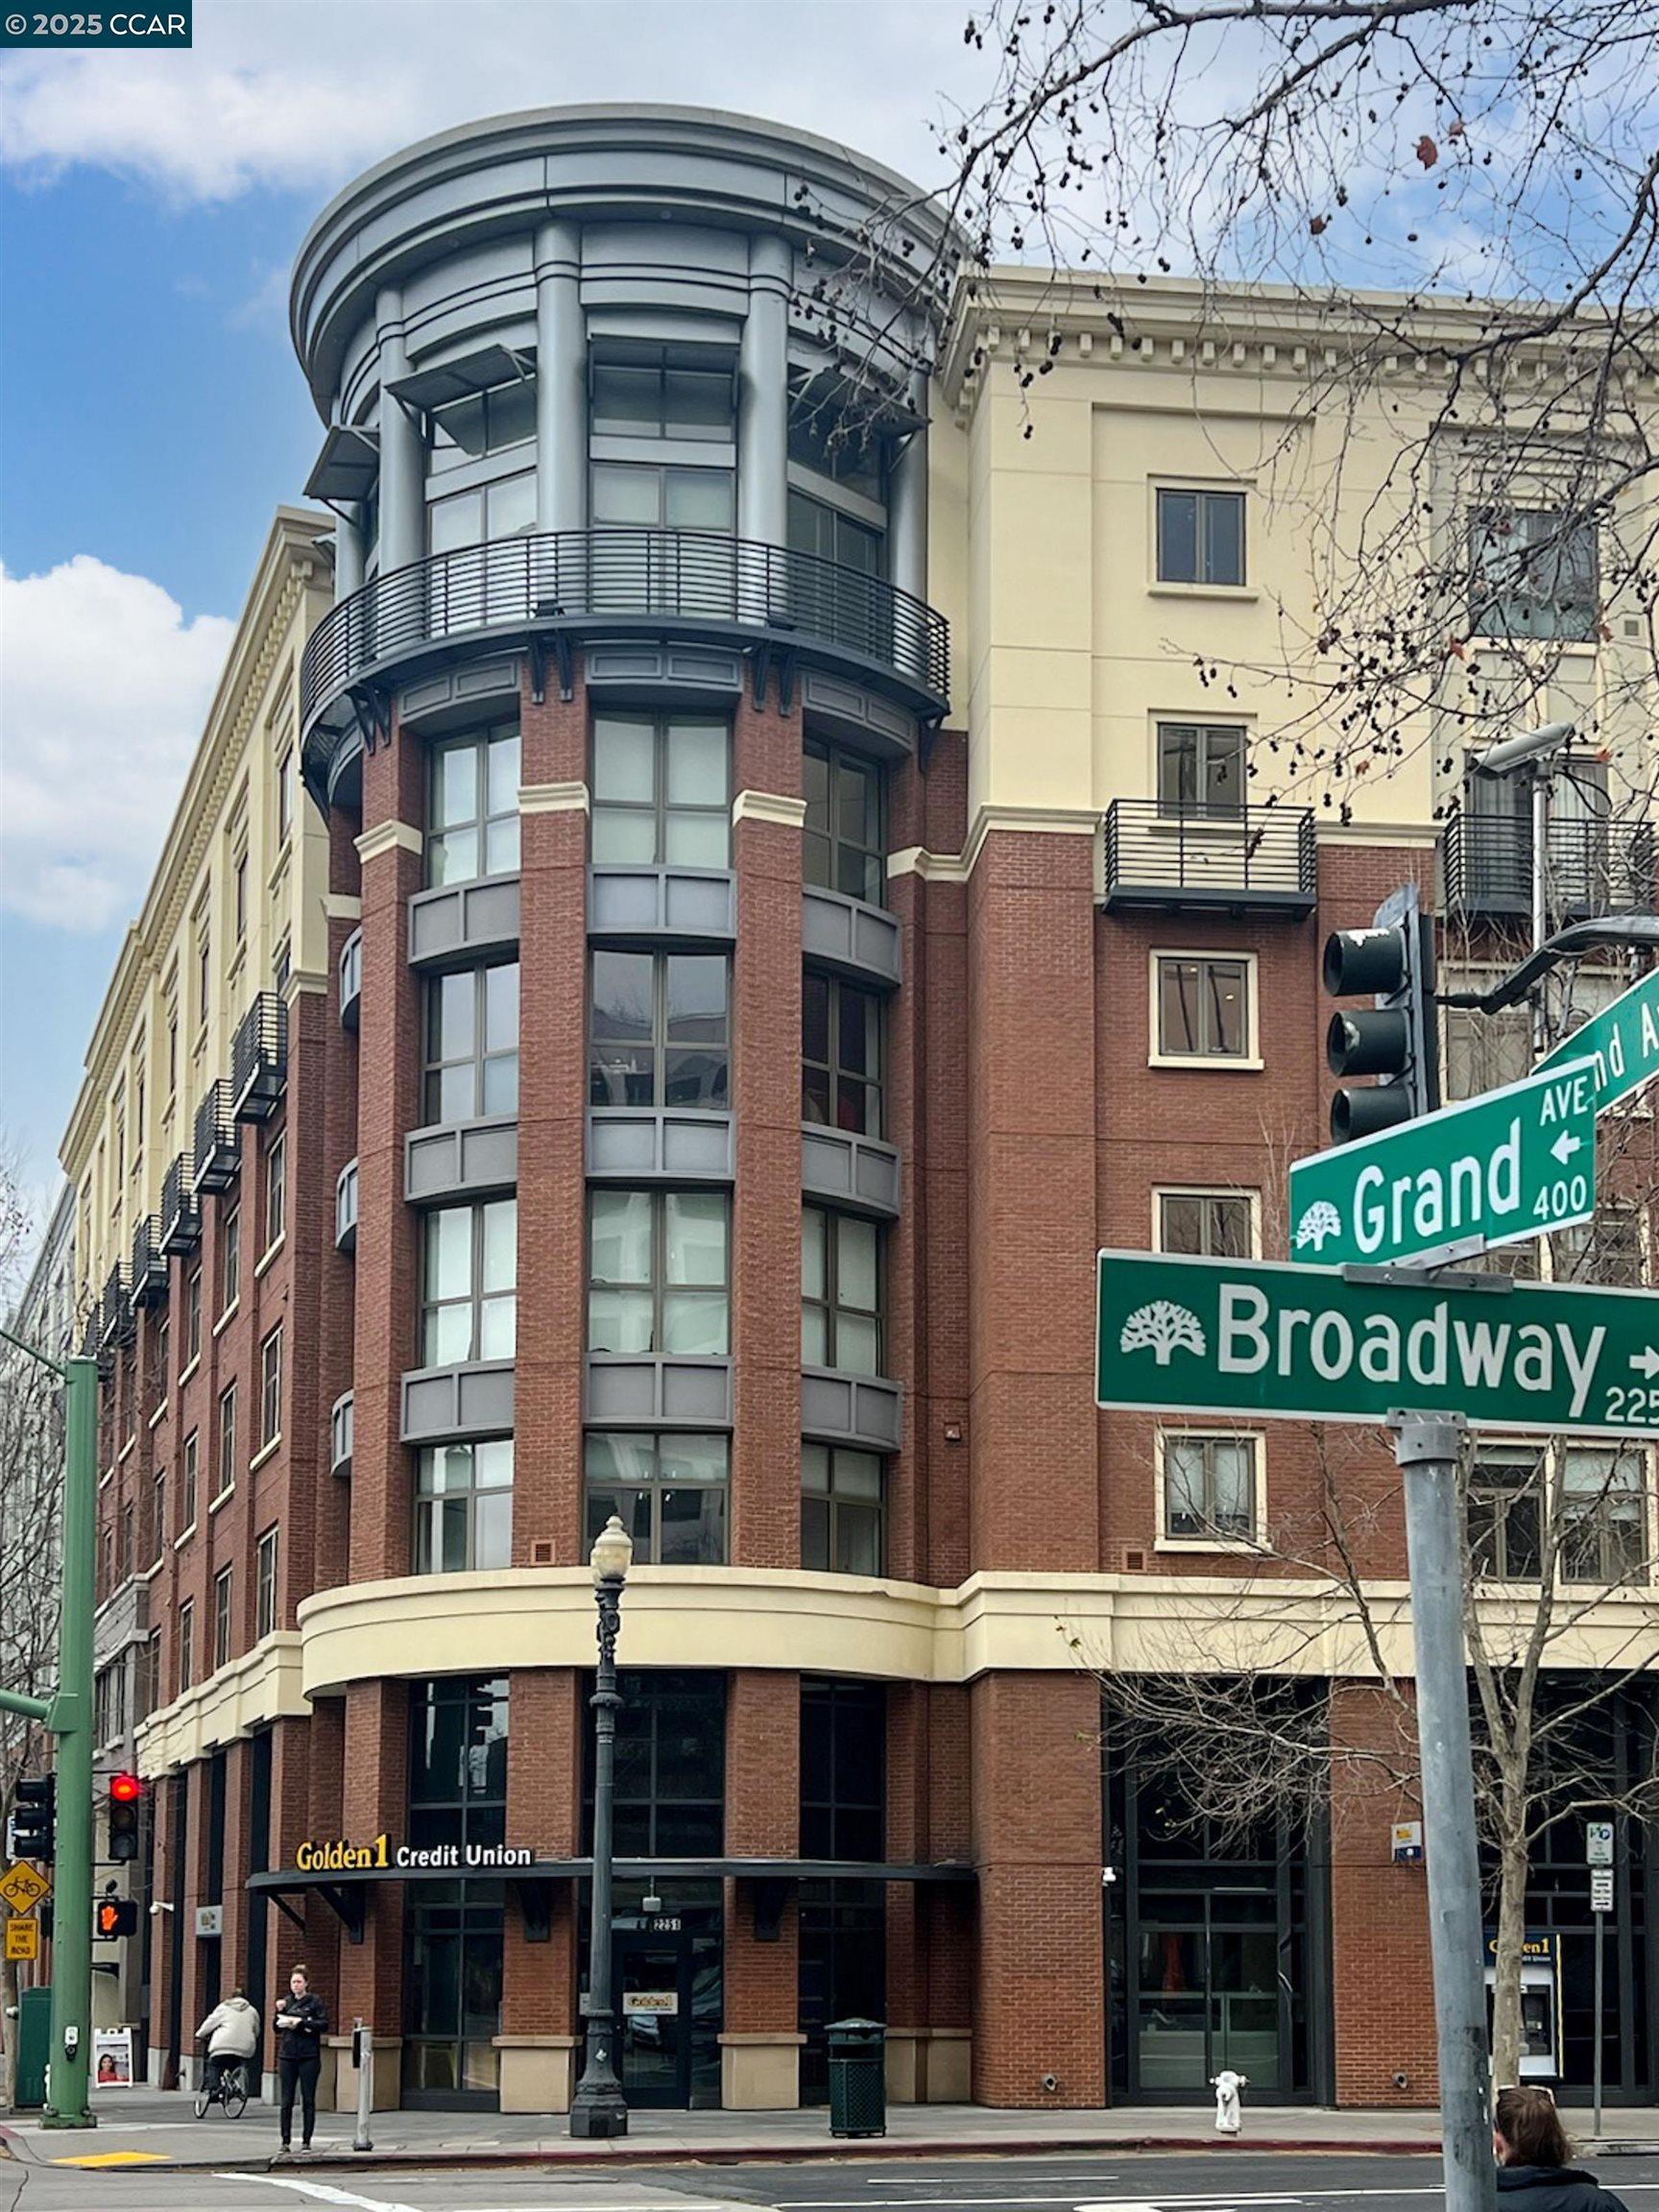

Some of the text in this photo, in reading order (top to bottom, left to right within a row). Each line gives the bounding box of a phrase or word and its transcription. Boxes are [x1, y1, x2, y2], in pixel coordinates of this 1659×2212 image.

[1353, 1075, 1588, 1254] Grand AVE
[1533, 1175, 1587, 1220] 400
[1217, 1284, 1606, 1418] Broadway
[397, 1845, 459, 1867] Credit
[466, 1844, 531, 1865] Union
[10, 1923, 34, 1932] SHARE
[15, 1935, 27, 1943] THE
[1489, 1937, 1550, 1954] Gen1
[11, 1945, 31, 1955] ROAD
